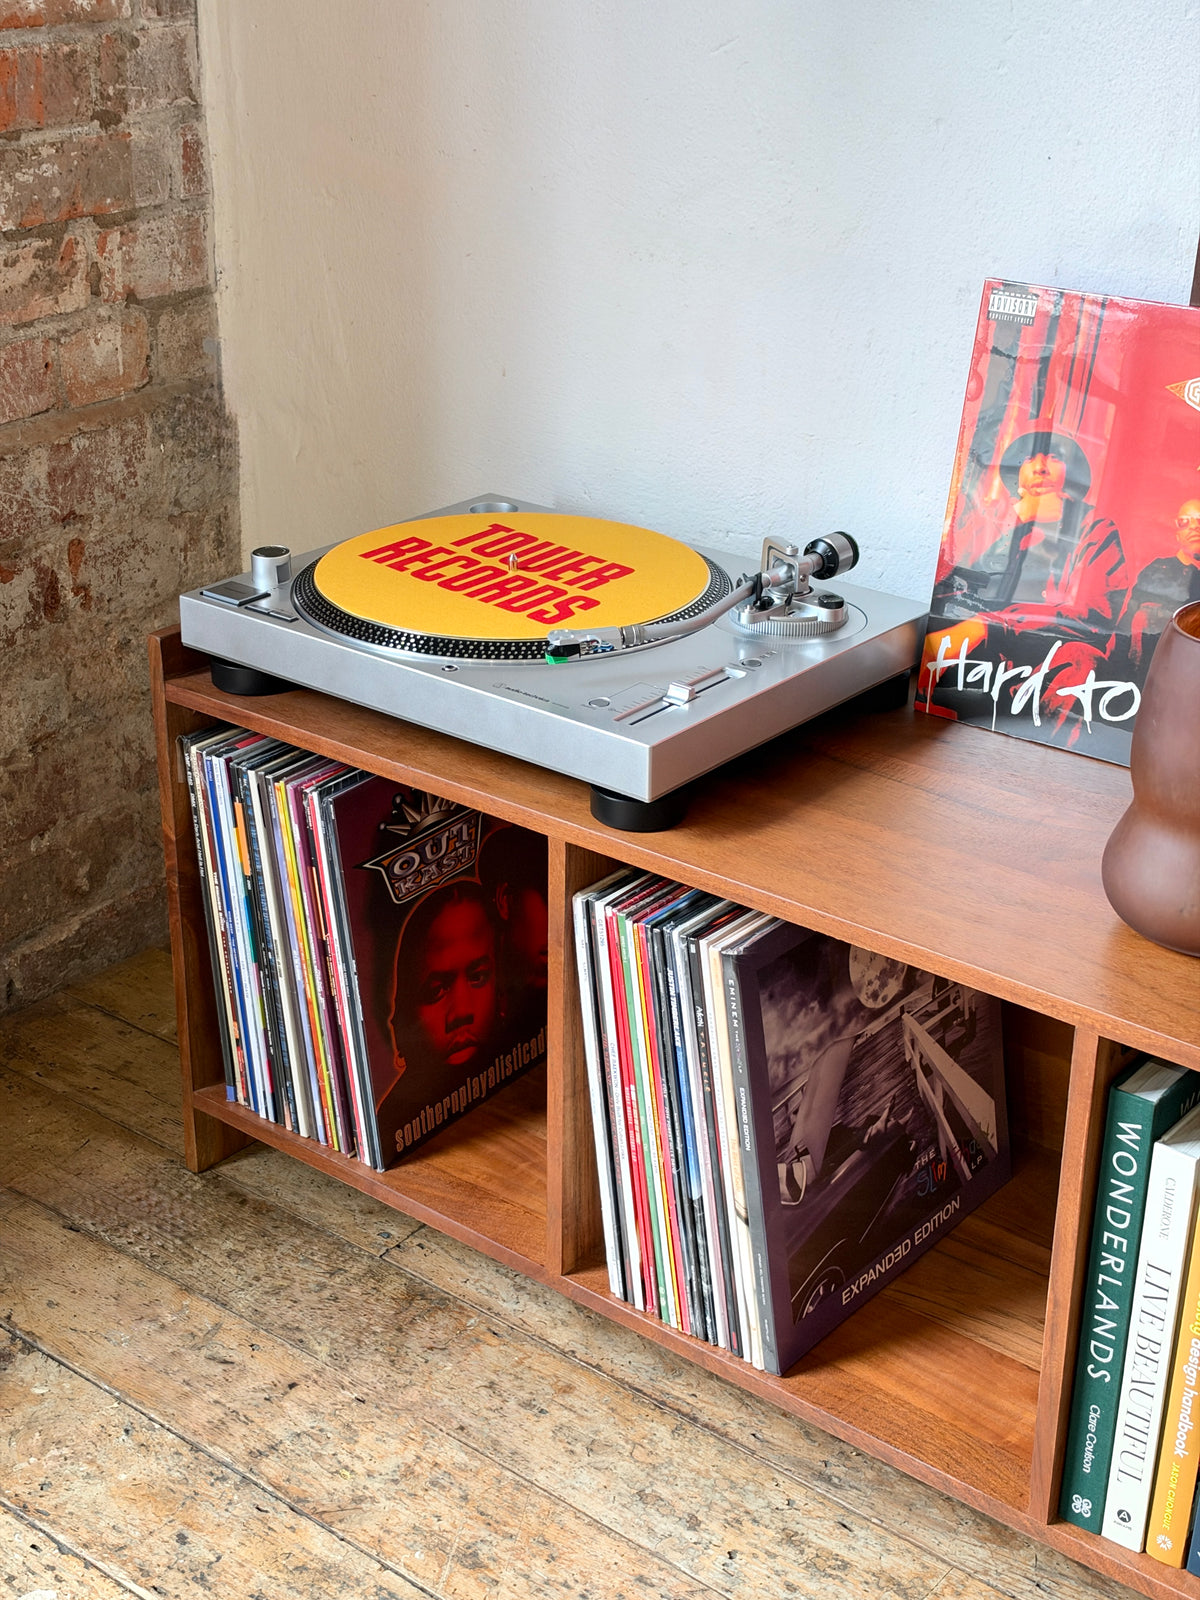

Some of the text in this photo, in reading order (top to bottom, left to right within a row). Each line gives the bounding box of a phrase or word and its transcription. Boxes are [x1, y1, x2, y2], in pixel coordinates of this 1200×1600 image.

[990, 296, 1036, 316] ADVISORY
[990, 312, 1032, 325] EXPLICIT LYRICS
[358, 536, 600, 625] RECORDS
[450, 523, 635, 591] TOWER
[926, 635, 1142, 728] Hard to
[388, 818, 476, 879] OUT
[394, 841, 475, 898] KAST
[666, 967, 676, 995] JUSTIN
[727, 977, 738, 1027] EMINEM
[670, 996, 681, 1047] TIMBERLAKE
[395, 1023, 548, 1153] southernplayalisticad
[742, 1123, 751, 1151] EDITION
[914, 1148, 936, 1170] THE
[971, 1154, 983, 1170] LP
[914, 1196, 960, 1246] EDITION
[1158, 1177, 1176, 1241] CALDERONE
[1086, 1122, 1142, 1383] WONDERLANDS
[1116, 1260, 1172, 1485] LIVE BEAUTIFUL
[1082, 1404, 1100, 1474] Clare Coulson
[1174, 1386, 1199, 1458] handbook
[1162, 1462, 1180, 1531] JASON CHONGUE
